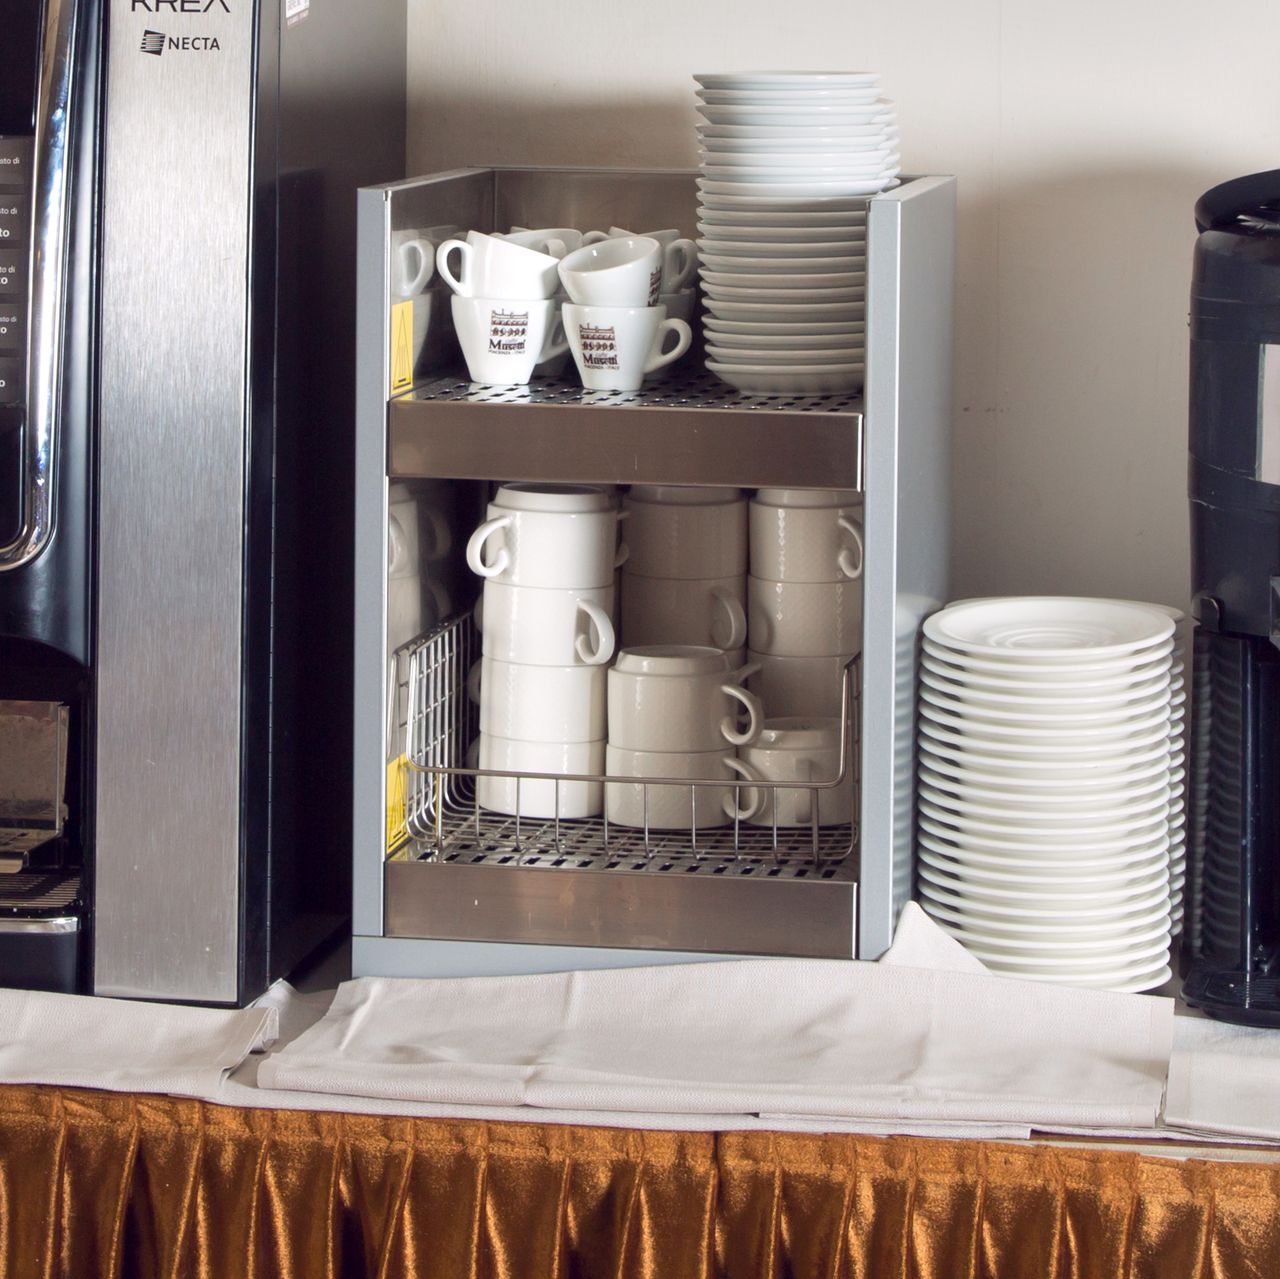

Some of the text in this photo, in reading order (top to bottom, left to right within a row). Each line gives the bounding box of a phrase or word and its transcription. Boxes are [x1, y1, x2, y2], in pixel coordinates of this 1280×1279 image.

[168, 36, 220, 50] NECTA
[10, 207, 17, 215] di
[7, 266, 15, 274] di
[489, 338, 526, 351] Musetti
[582, 352, 618, 365] Musetti
